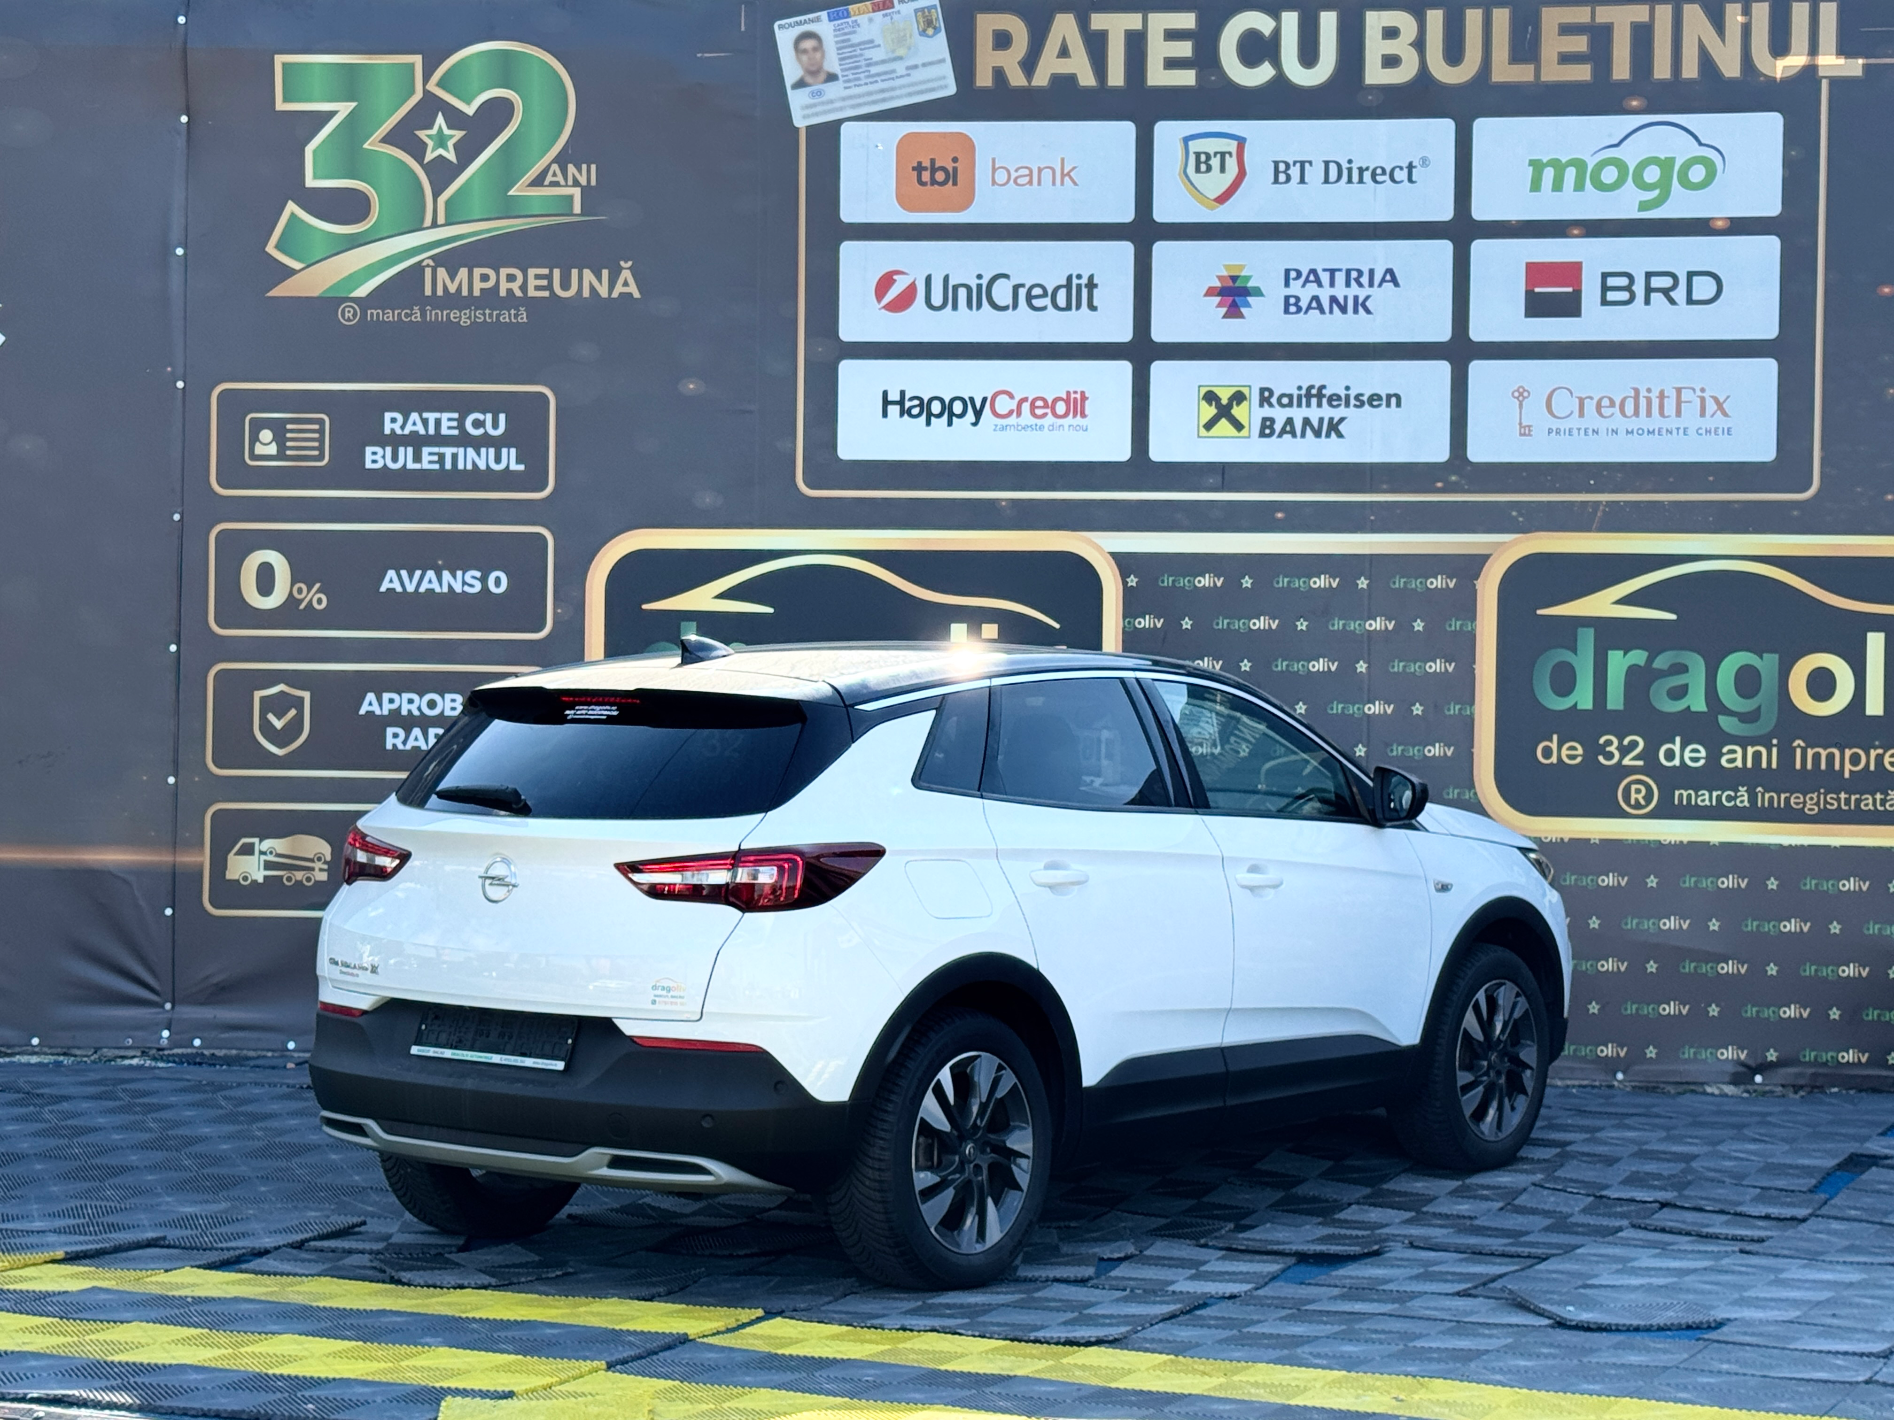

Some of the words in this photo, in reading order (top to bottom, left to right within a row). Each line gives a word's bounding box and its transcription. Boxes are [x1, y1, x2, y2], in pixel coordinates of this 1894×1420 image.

[777, 15, 823, 32] ROUMANIE
[974, 11, 1197, 88] RATE
[1218, 10, 1340, 88] CU
[1365, 2, 1863, 85] BULETINUL
[912, 157, 959, 187] tbi
[990, 157, 1079, 187] bank
[1193, 151, 1232, 174] BT
[1271, 160, 1313, 185] BT
[543, 164, 597, 187] ANI
[1528, 156, 1718, 212] mogo
[421, 260, 641, 299] ÎMPREUNĂ
[1283, 267, 1401, 288] PATRIA
[1600, 270, 1724, 307] BRD
[924, 273, 1098, 313] UniCredit
[366, 306, 422, 322] marcă
[425, 305, 528, 327] înregistrată
[1283, 295, 1374, 315] BANK
[881, 389, 1089, 427] HappyCredit
[1258, 386, 1402, 411] Raiffeisen
[1545, 386, 1732, 420] CreditFix
[383, 412, 459, 436] RATE
[464, 412, 506, 436] CU
[992, 422, 1045, 433] zambeste
[1047, 421, 1065, 432] din
[1068, 423, 1089, 432] nou
[1257, 416, 1346, 439] BANK
[1547, 427, 1600, 437] PRIETEN
[1606, 427, 1619, 437] IN
[1625, 427, 1689, 437] MOMENTE
[1696, 427, 1733, 437] CHEIE
[364, 446, 525, 471] BULETINUL
[379, 569, 482, 594] AVANS
[488, 570, 508, 594] 0
[1159, 573, 1224, 590] dragoliv
[1273, 574, 1339, 591] dragoliv
[1390, 574, 1456, 592] dragoliv
[1213, 615, 1279, 632] dragoliv
[1328, 616, 1395, 634] dragoliv
[1272, 657, 1338, 674] dragoliv
[1389, 658, 1455, 676] dragoliv
[358, 692, 464, 716] APROB
[1326, 700, 1394, 717] dragoliv
[385, 726, 445, 750] RAP
[1387, 743, 1454, 760] dragoliv
[1536, 734, 1583, 765] de
[1597, 735, 1645, 766] 32
[1658, 736, 1706, 767] de
[1720, 739, 1778, 769] ani
[1674, 787, 1749, 808] marcă
[1561, 872, 1628, 889] dragoliv
[1680, 874, 1748, 891] dragoliv
[1801, 876, 1869, 894] dragoliv
[1621, 915, 1690, 933] dragoliv
[1741, 917, 1811, 935] dragoliv
[1680, 959, 1748, 977] dragoliv
[1801, 962, 1869, 979] dragoliv
[1621, 1001, 1689, 1018] dragoliv
[1741, 1003, 1810, 1021] dragoliv
[1679, 1045, 1747, 1062] dragoliv
[1801, 1048, 1869, 1066] dragoliv
